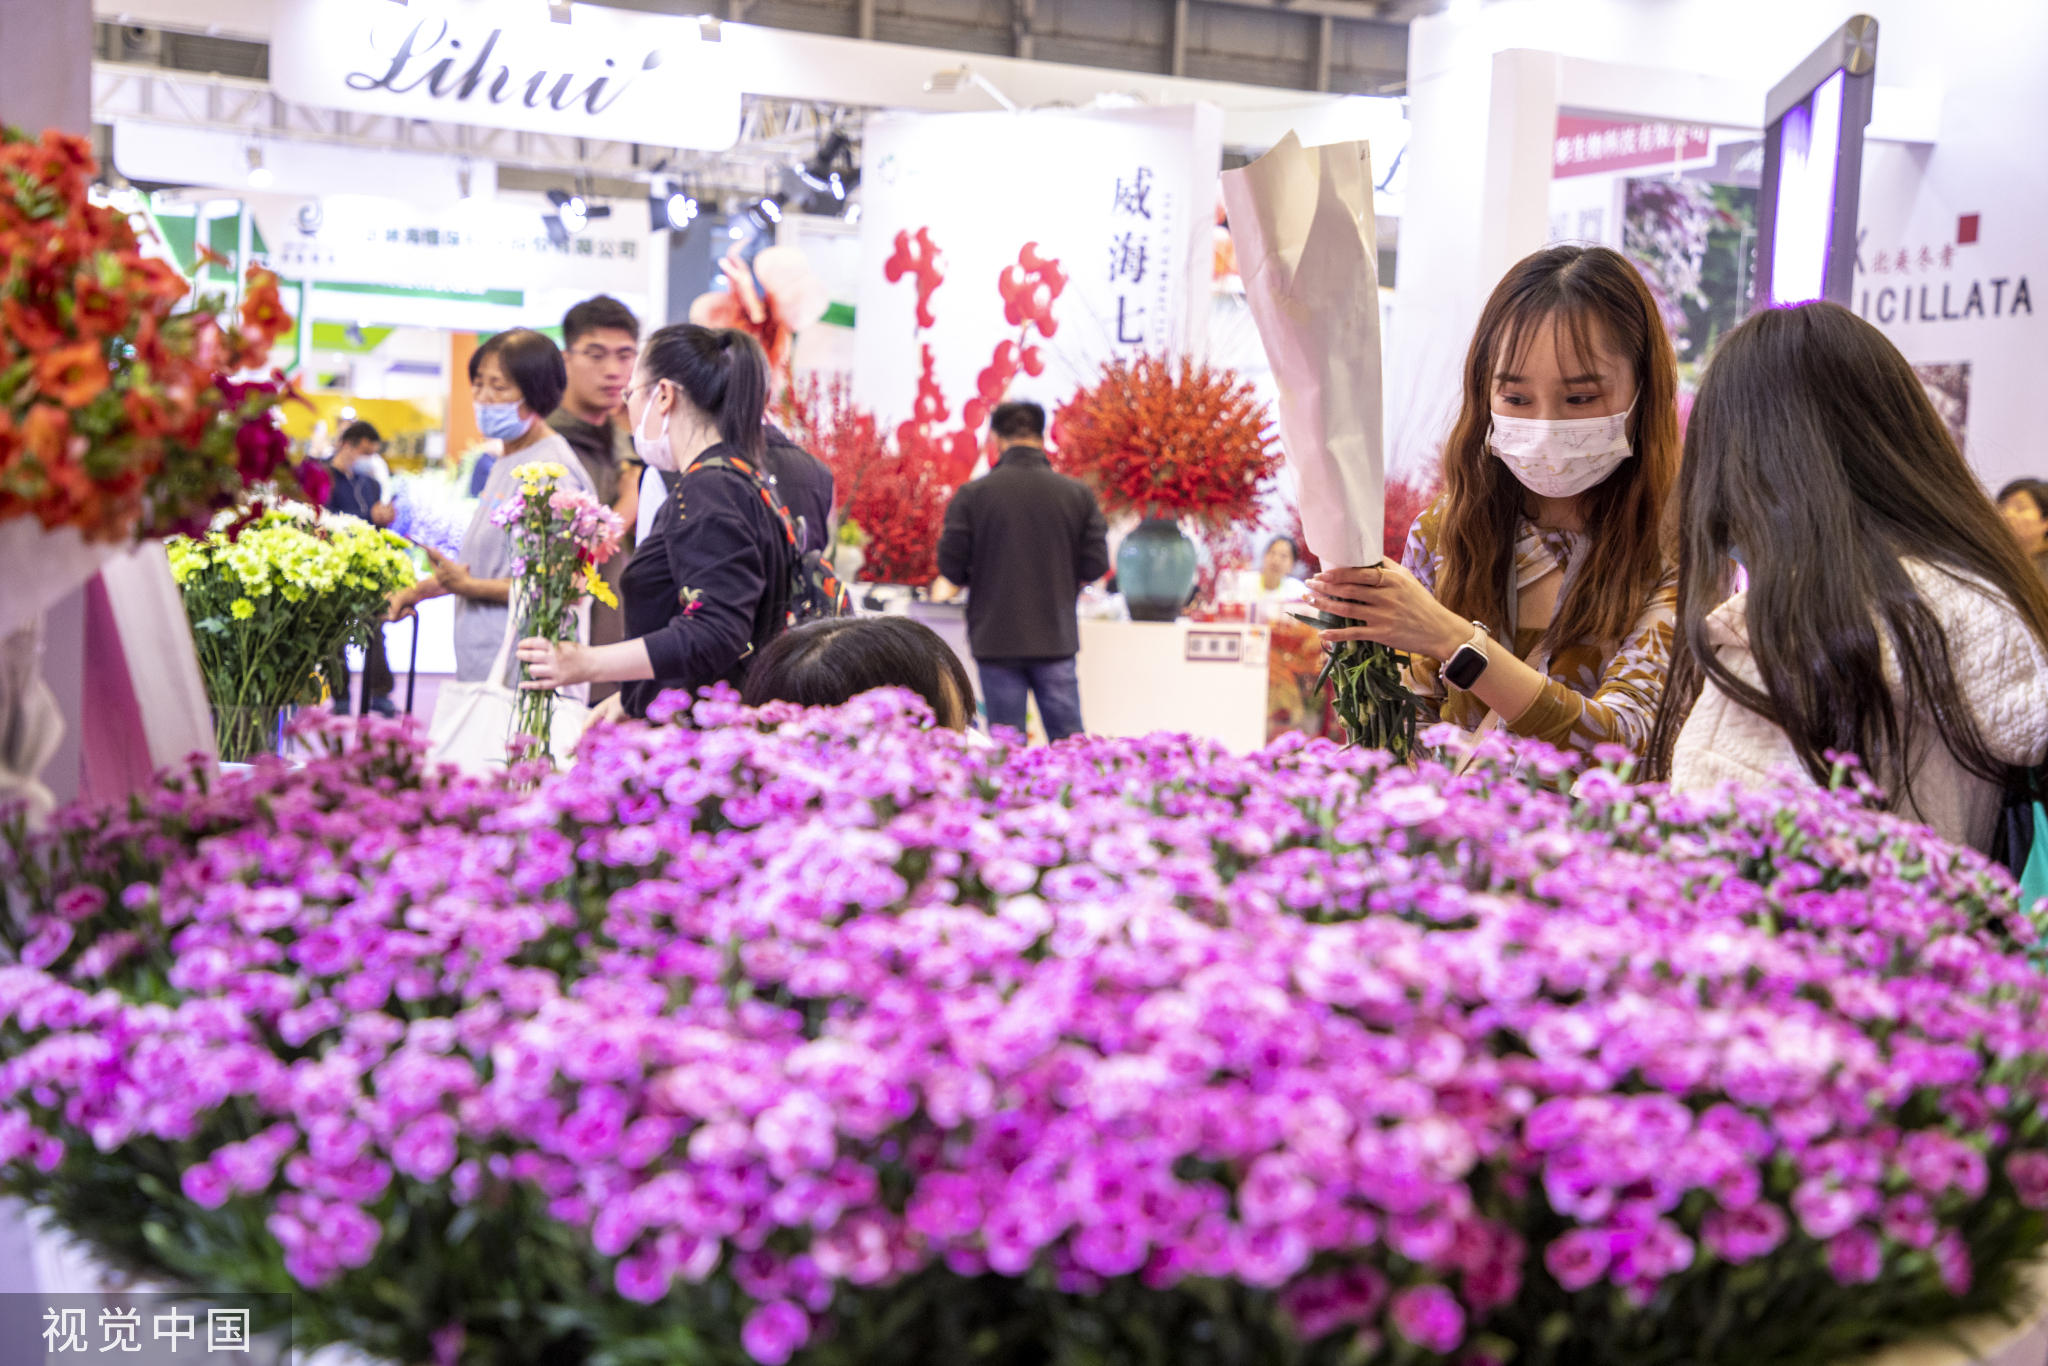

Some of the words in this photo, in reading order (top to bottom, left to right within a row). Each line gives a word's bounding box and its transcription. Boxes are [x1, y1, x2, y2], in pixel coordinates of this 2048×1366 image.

[346, 17, 662, 115] Lihui
[1108, 165, 1152, 364] 威海七
